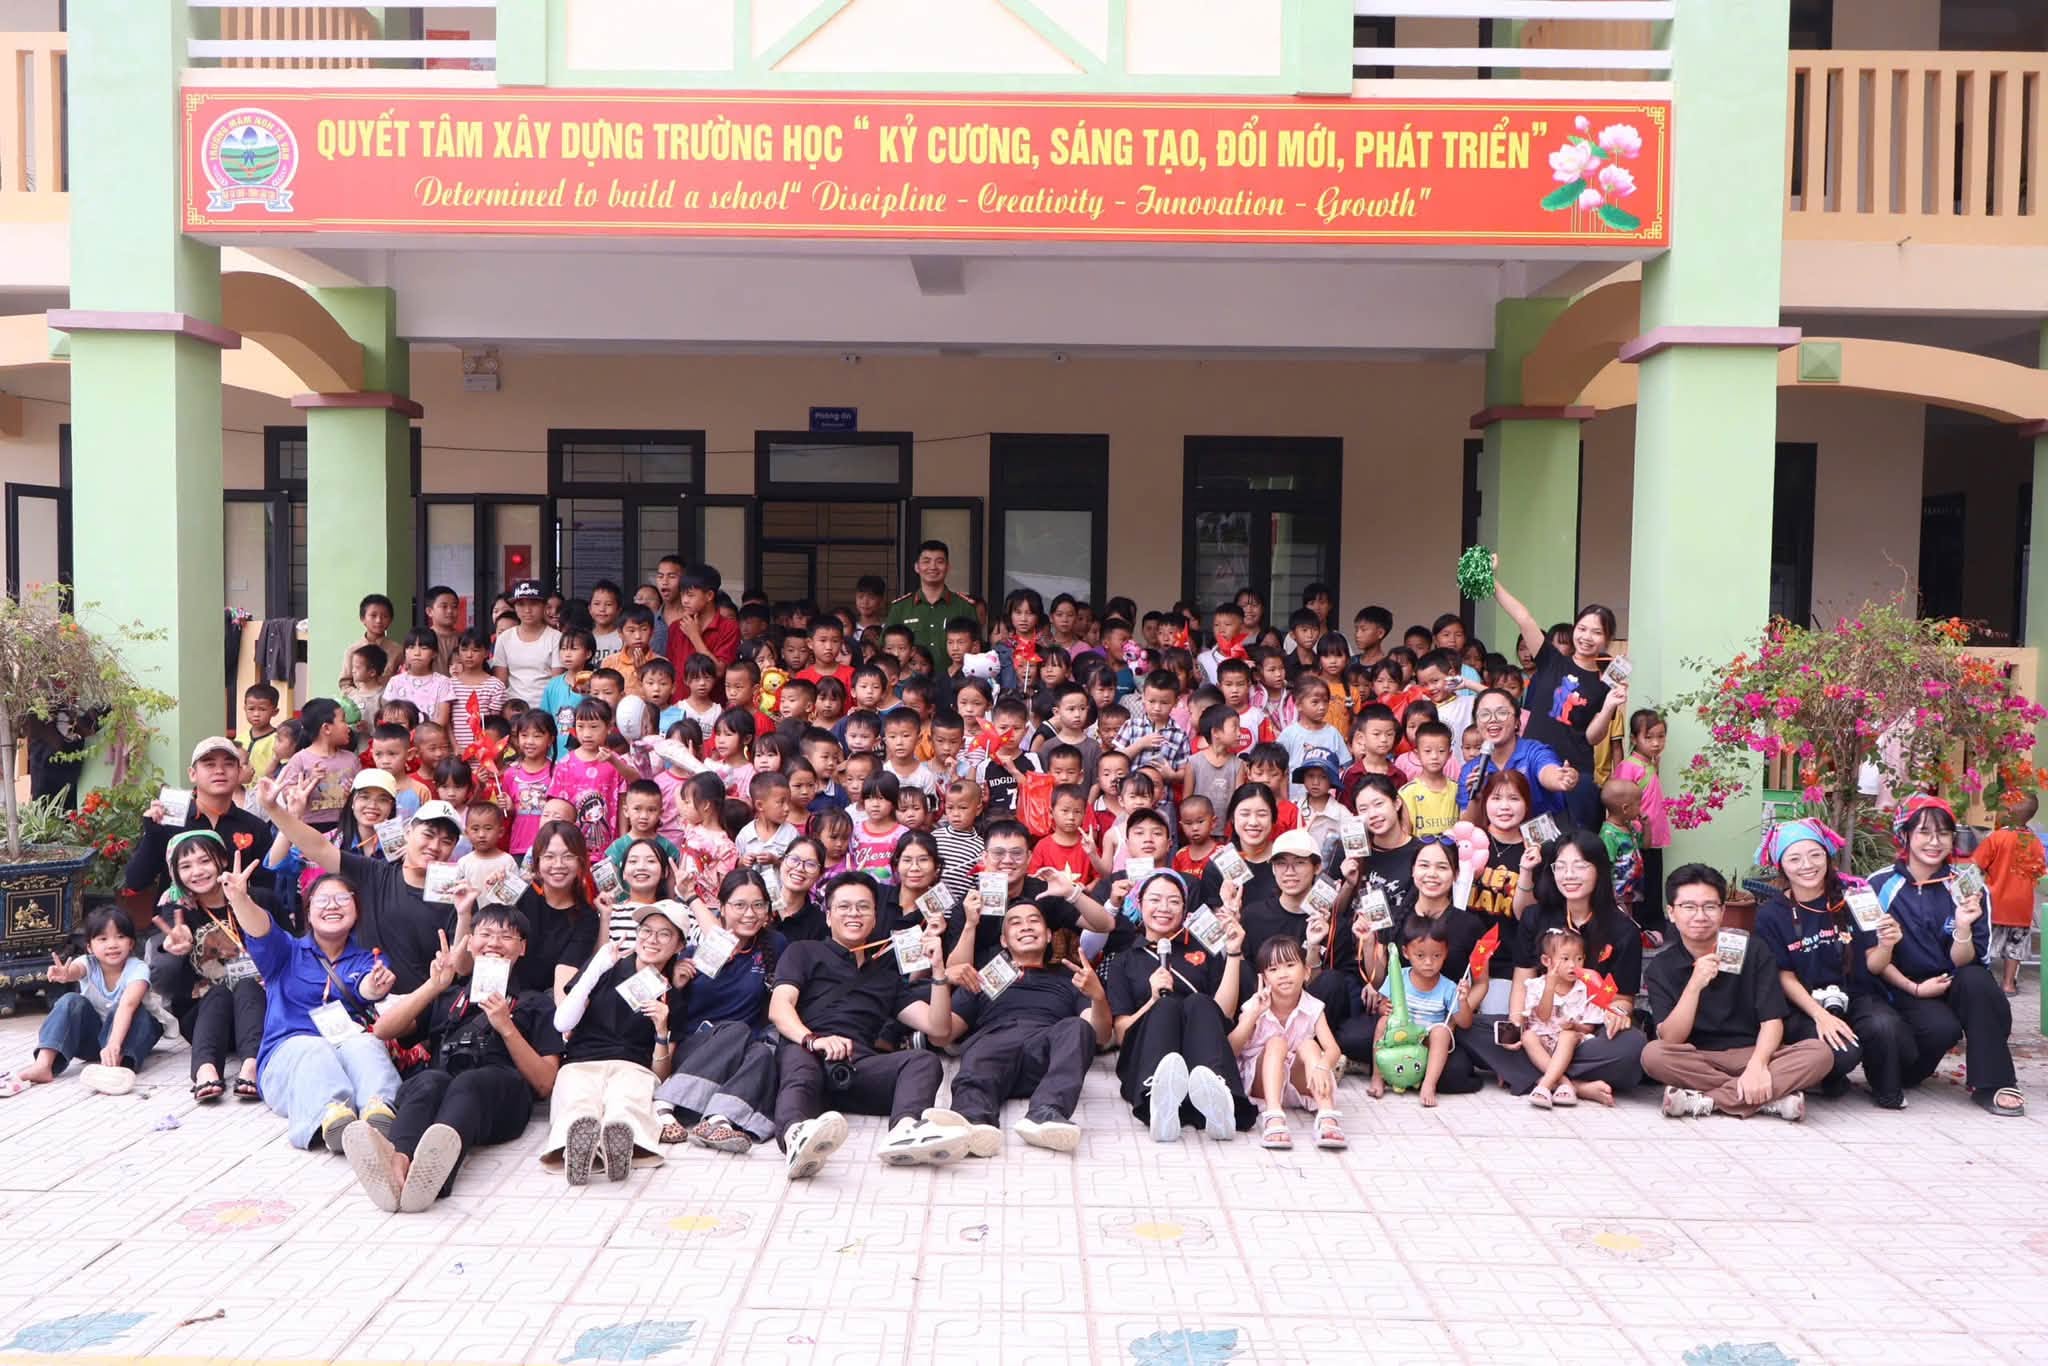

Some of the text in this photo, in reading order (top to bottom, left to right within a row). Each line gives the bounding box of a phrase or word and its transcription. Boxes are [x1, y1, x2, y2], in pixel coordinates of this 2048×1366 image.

[316, 108, 411, 161] QUYẾT
[418, 112, 484, 160] TÂM
[493, 113, 553, 160] XÂY
[560, 118, 645, 169] DỰNG
[652, 114, 774, 162] TRƯỜNG
[782, 124, 844, 171] HỌC
[879, 112, 918, 164] KỶ
[927, 122, 1040, 170] CƯƠNG,
[1049, 119, 1134, 167] SÁNG
[1141, 128, 1208, 175] TẠO,
[1215, 114, 1268, 168] ĐỔI
[1277, 122, 1345, 174] MỚI,
[1355, 122, 1434, 169] PHÁT
[413, 175, 567, 208] Determined
[574, 181, 599, 208] to
[607, 179, 677, 209] build
[684, 190, 700, 209] a
[812, 180, 947, 219] Discipline
[976, 182, 1105, 221] Creativity
[1135, 184, 1285, 216] Innovation
[1481, 864, 1518, 897] IỆT
